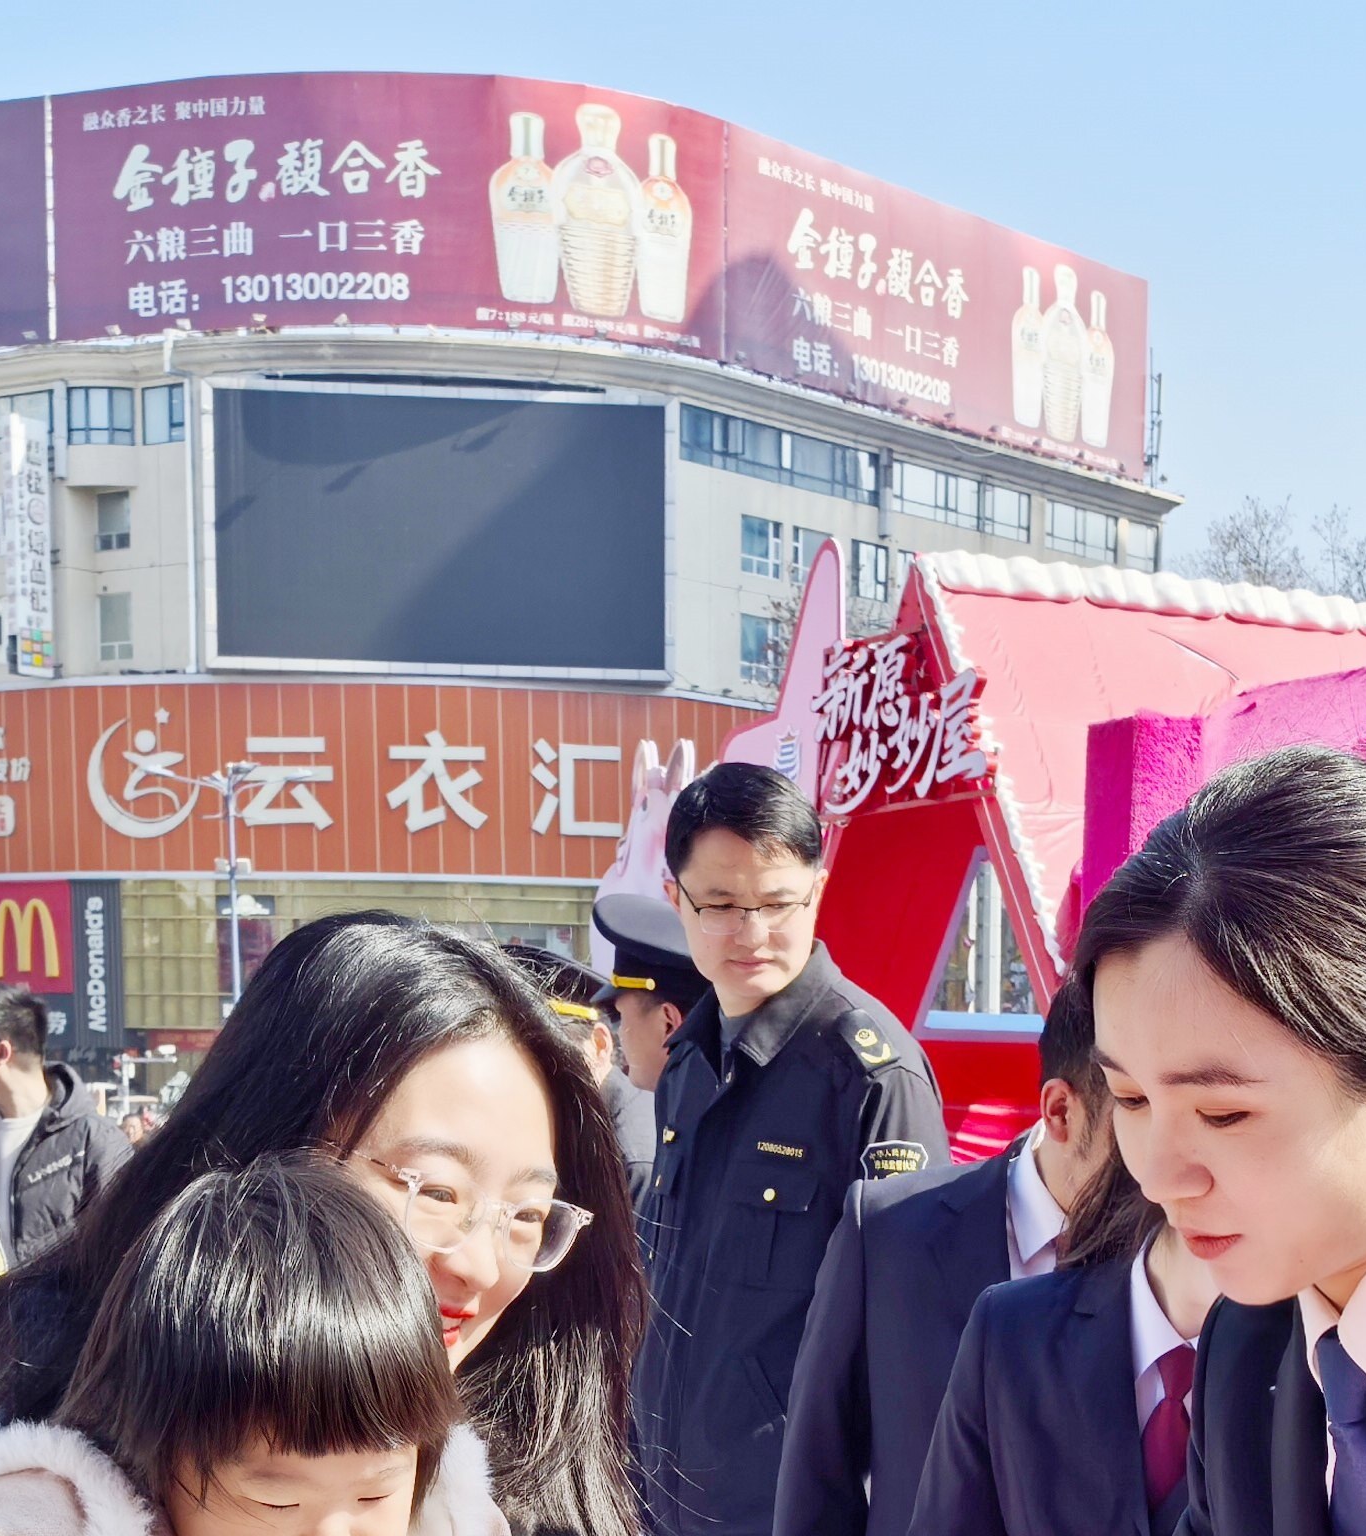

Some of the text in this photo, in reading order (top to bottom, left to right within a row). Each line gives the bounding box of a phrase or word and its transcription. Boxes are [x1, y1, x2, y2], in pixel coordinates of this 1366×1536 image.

[124, 219, 426, 265] 六粮三曲 一口三香
[221, 272, 410, 304] 13013002208
[792, 287, 959, 368] 六粮三曲 一口三香
[852, 354, 951, 406] 13013002208
[241, 730, 621, 838] 云衣汇
[86, 896, 108, 1034] McDonald's
